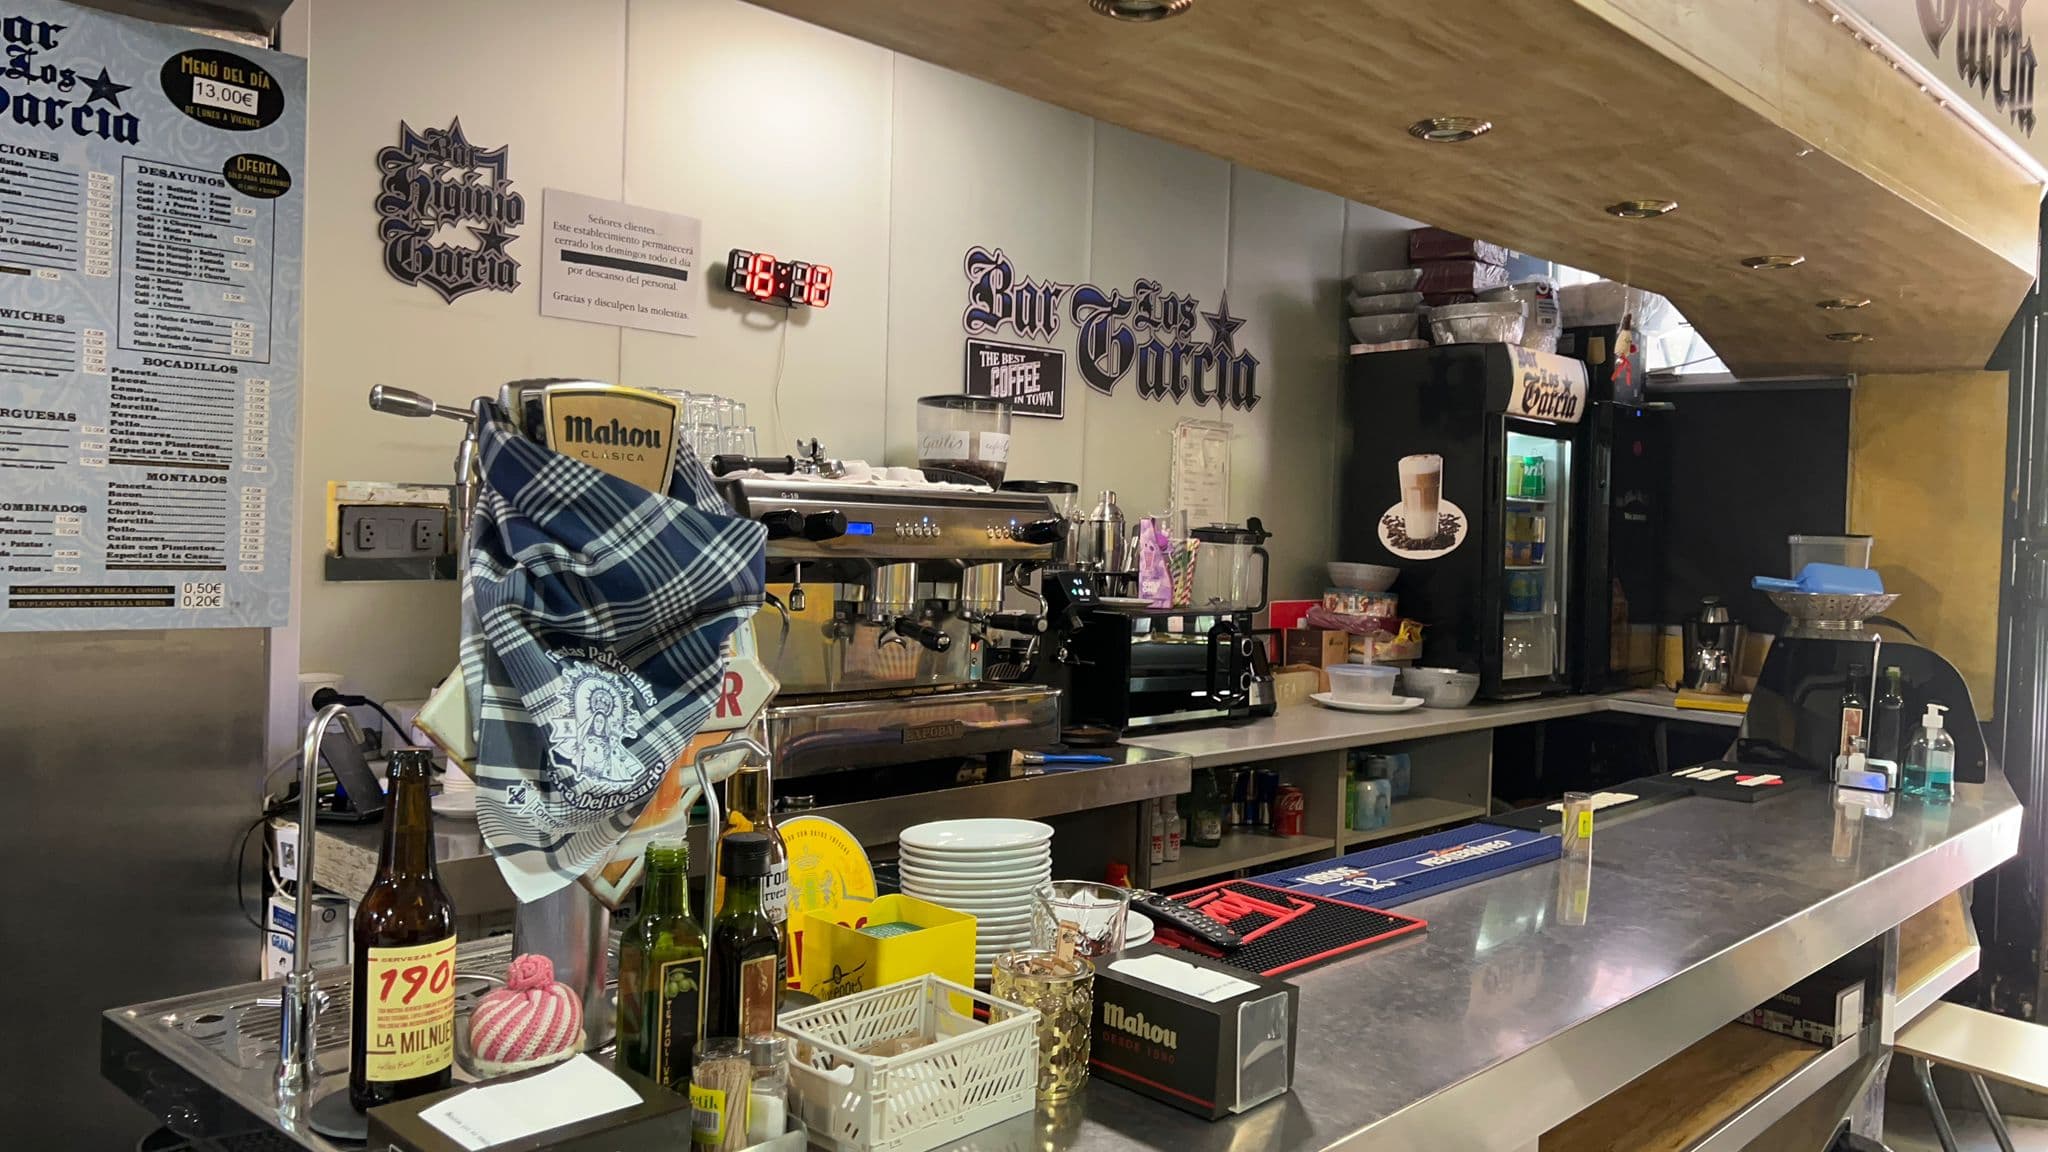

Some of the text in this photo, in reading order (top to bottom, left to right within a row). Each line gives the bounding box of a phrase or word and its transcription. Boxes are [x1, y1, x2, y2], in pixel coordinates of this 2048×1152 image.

[0, 16, 68, 51] ar
[5, 44, 76, 92] Los
[181, 55, 271, 89] MENÚ DEL DÍA
[195, 82, 253, 107] 13,00€
[424, 127, 488, 168] Bar
[236, 156, 278, 177] OFERTA
[138, 165, 226, 189] DESAYUNOS
[376, 146, 525, 232] Higinio
[588, 214, 623, 229] Señores
[553, 221, 694, 256] Este establecimiento permanecerá
[554, 236, 691, 268] cerrado los domingos todo el día
[567, 265, 583, 277] por
[585, 267, 624, 282] descanso
[626, 273, 639, 285] del
[553, 290, 586, 305] Gracias
[587, 296, 593, 305] y
[594, 297, 635, 314] disculpen
[637, 303, 649, 314] las
[962, 246, 1074, 343] Bar
[1133, 277, 1200, 343] Los
[1069, 283, 1262, 413] Garcia
[142, 357, 238, 374] BOCADILLOS
[979, 351, 1026, 368] THE BEST
[111, 367, 158, 377] Panceta
[111, 376, 147, 385] Bacon
[990, 361, 1041, 399] COFFEE
[1540, 368, 1559, 388] Los
[110, 393, 158, 403] Chorizo
[111, 385, 143, 393] Lomo
[1521, 372, 1578, 419] Garcia
[110, 402, 160, 412] Morcilla
[1014, 391, 1054, 407] IN TOWN
[110, 411, 157, 420] Ternera
[110, 429, 171, 439] Calamares
[564, 415, 661, 449] Mahou
[109, 437, 139, 446] Atún
[165, 441, 220, 450] Pimientos
[109, 446, 216, 458] Especial de la Casa
[108, 482, 152, 490] Panceta
[146, 472, 228, 484] MONTADOS
[108, 499, 139, 507] Lomo
[108, 508, 154, 516] Chorizo
[107, 517, 154, 525] Morcilla
[107, 525, 136, 533] Pollo
[106, 552, 153, 561] Especial
[184, 582, 222, 595] 0,50€
[183, 596, 221, 607] 0,20€
[588, 646, 658, 707] Patronales
[713, 671, 744, 718] R
[1278, 684, 1297, 697] TEA
[580, 792, 606, 809] Del
[607, 761, 666, 808] Rosario
[382, 953, 432, 963] CERVEZAS
[380, 959, 457, 1004] 190
[1103, 1001, 1177, 1049] Mahou
[377, 1033, 394, 1048] LA
[1103, 1032, 1141, 1052] DESDE
